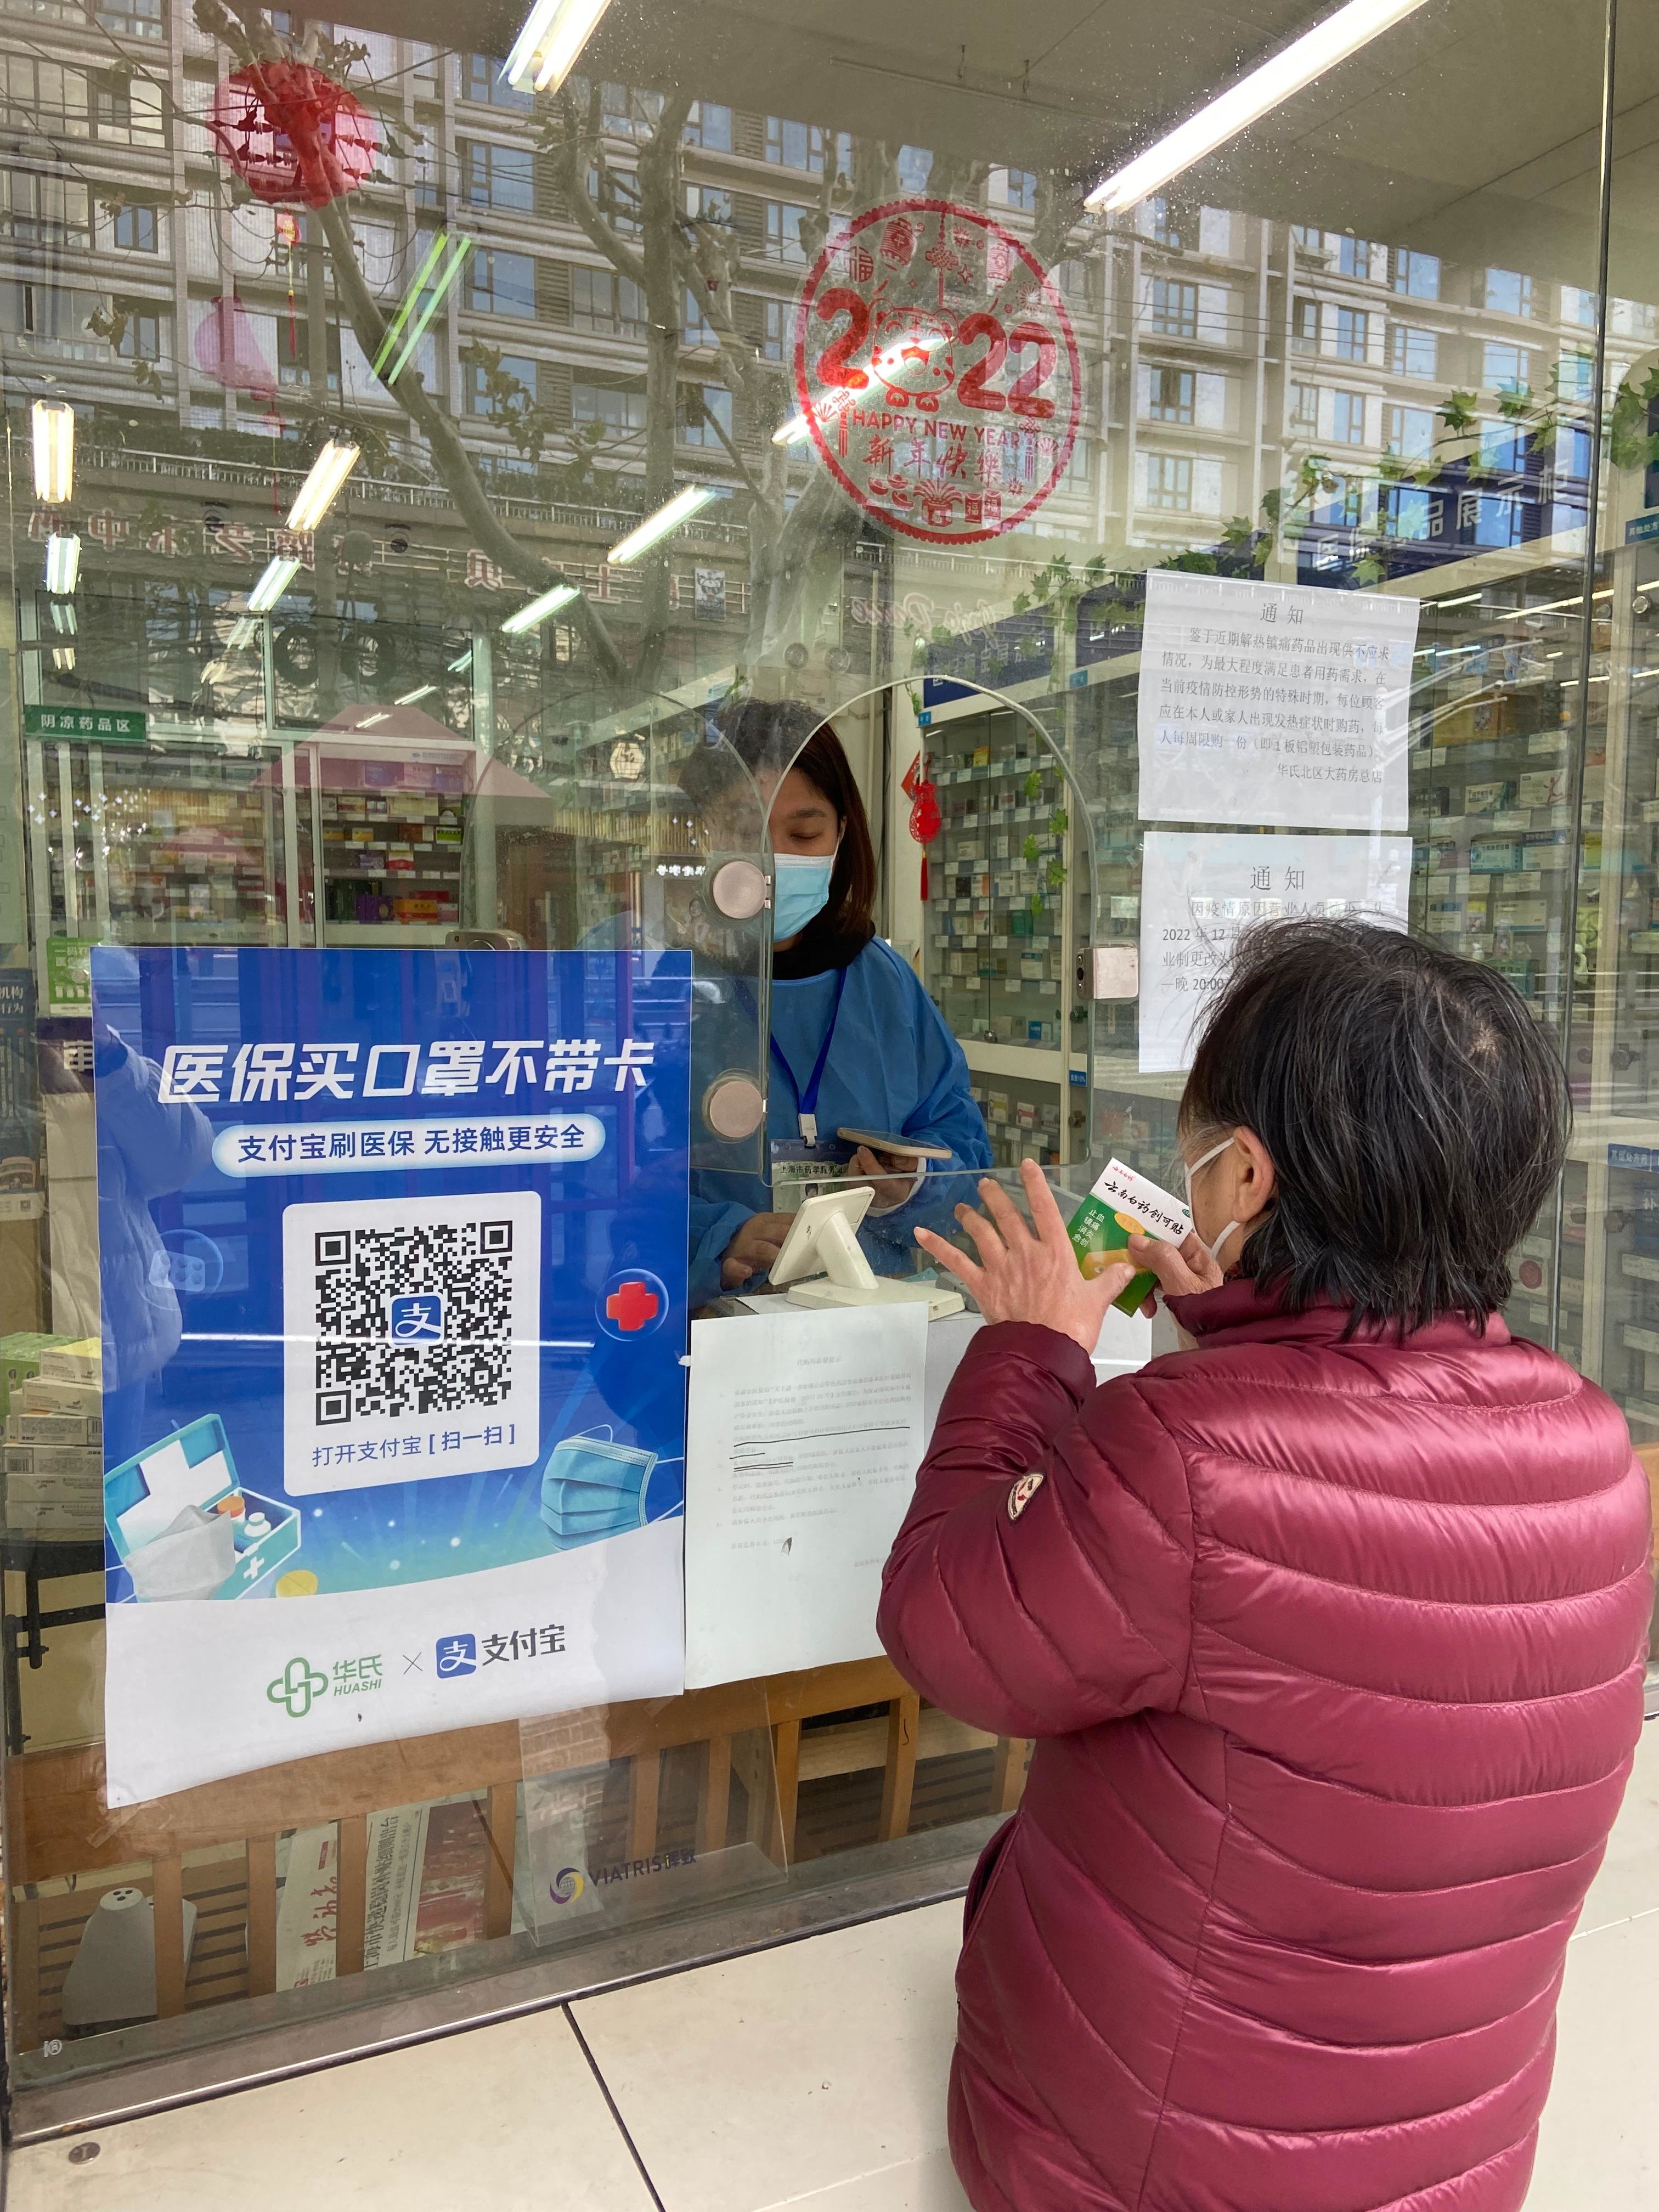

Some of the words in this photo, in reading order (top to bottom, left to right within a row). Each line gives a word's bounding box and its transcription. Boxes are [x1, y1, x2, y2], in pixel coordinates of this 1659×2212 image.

[852, 409, 918, 435] HAPPY
[924, 420, 968, 442] NEW
[974, 426, 1019, 448] YEAR
[863, 436, 1003, 484] 新年快樂
[1260, 603, 1304, 625] 通知
[1188, 627, 1389, 661] 鉴于近期解热镇痛药品出现供不应求
[1161, 651, 1386, 686] 情况，为最大程度满足患者用药需求，在
[1160, 678, 1385, 712] 当前疫情防控形势的特殊时期，每位顾客
[41, 714, 131, 733] 阴凉药品区
[1158, 703, 1384, 735] 应在本人或家人出现发热症状时购药，每
[1277, 763, 1383, 784] 华氏北区大药房总店
[1250, 866, 1305, 891] 通知
[157, 1038, 656, 1104] 医保买口罩不带卡
[238, 1128, 415, 1163] 支付宝刷医保
[424, 1124, 586, 1154] 无接触更安全
[1088, 1209, 1105, 1223] 止血
[1104, 1181, 1184, 1235] 云南白药创可贴
[312, 1436, 422, 1467] 打开支付宝
[332, 1653, 383, 1682] 华氏
[482, 1624, 566, 1666] 支付宝
[334, 1679, 382, 1697] HUASHI
[588, 1855, 662, 1887] VIATRIS
